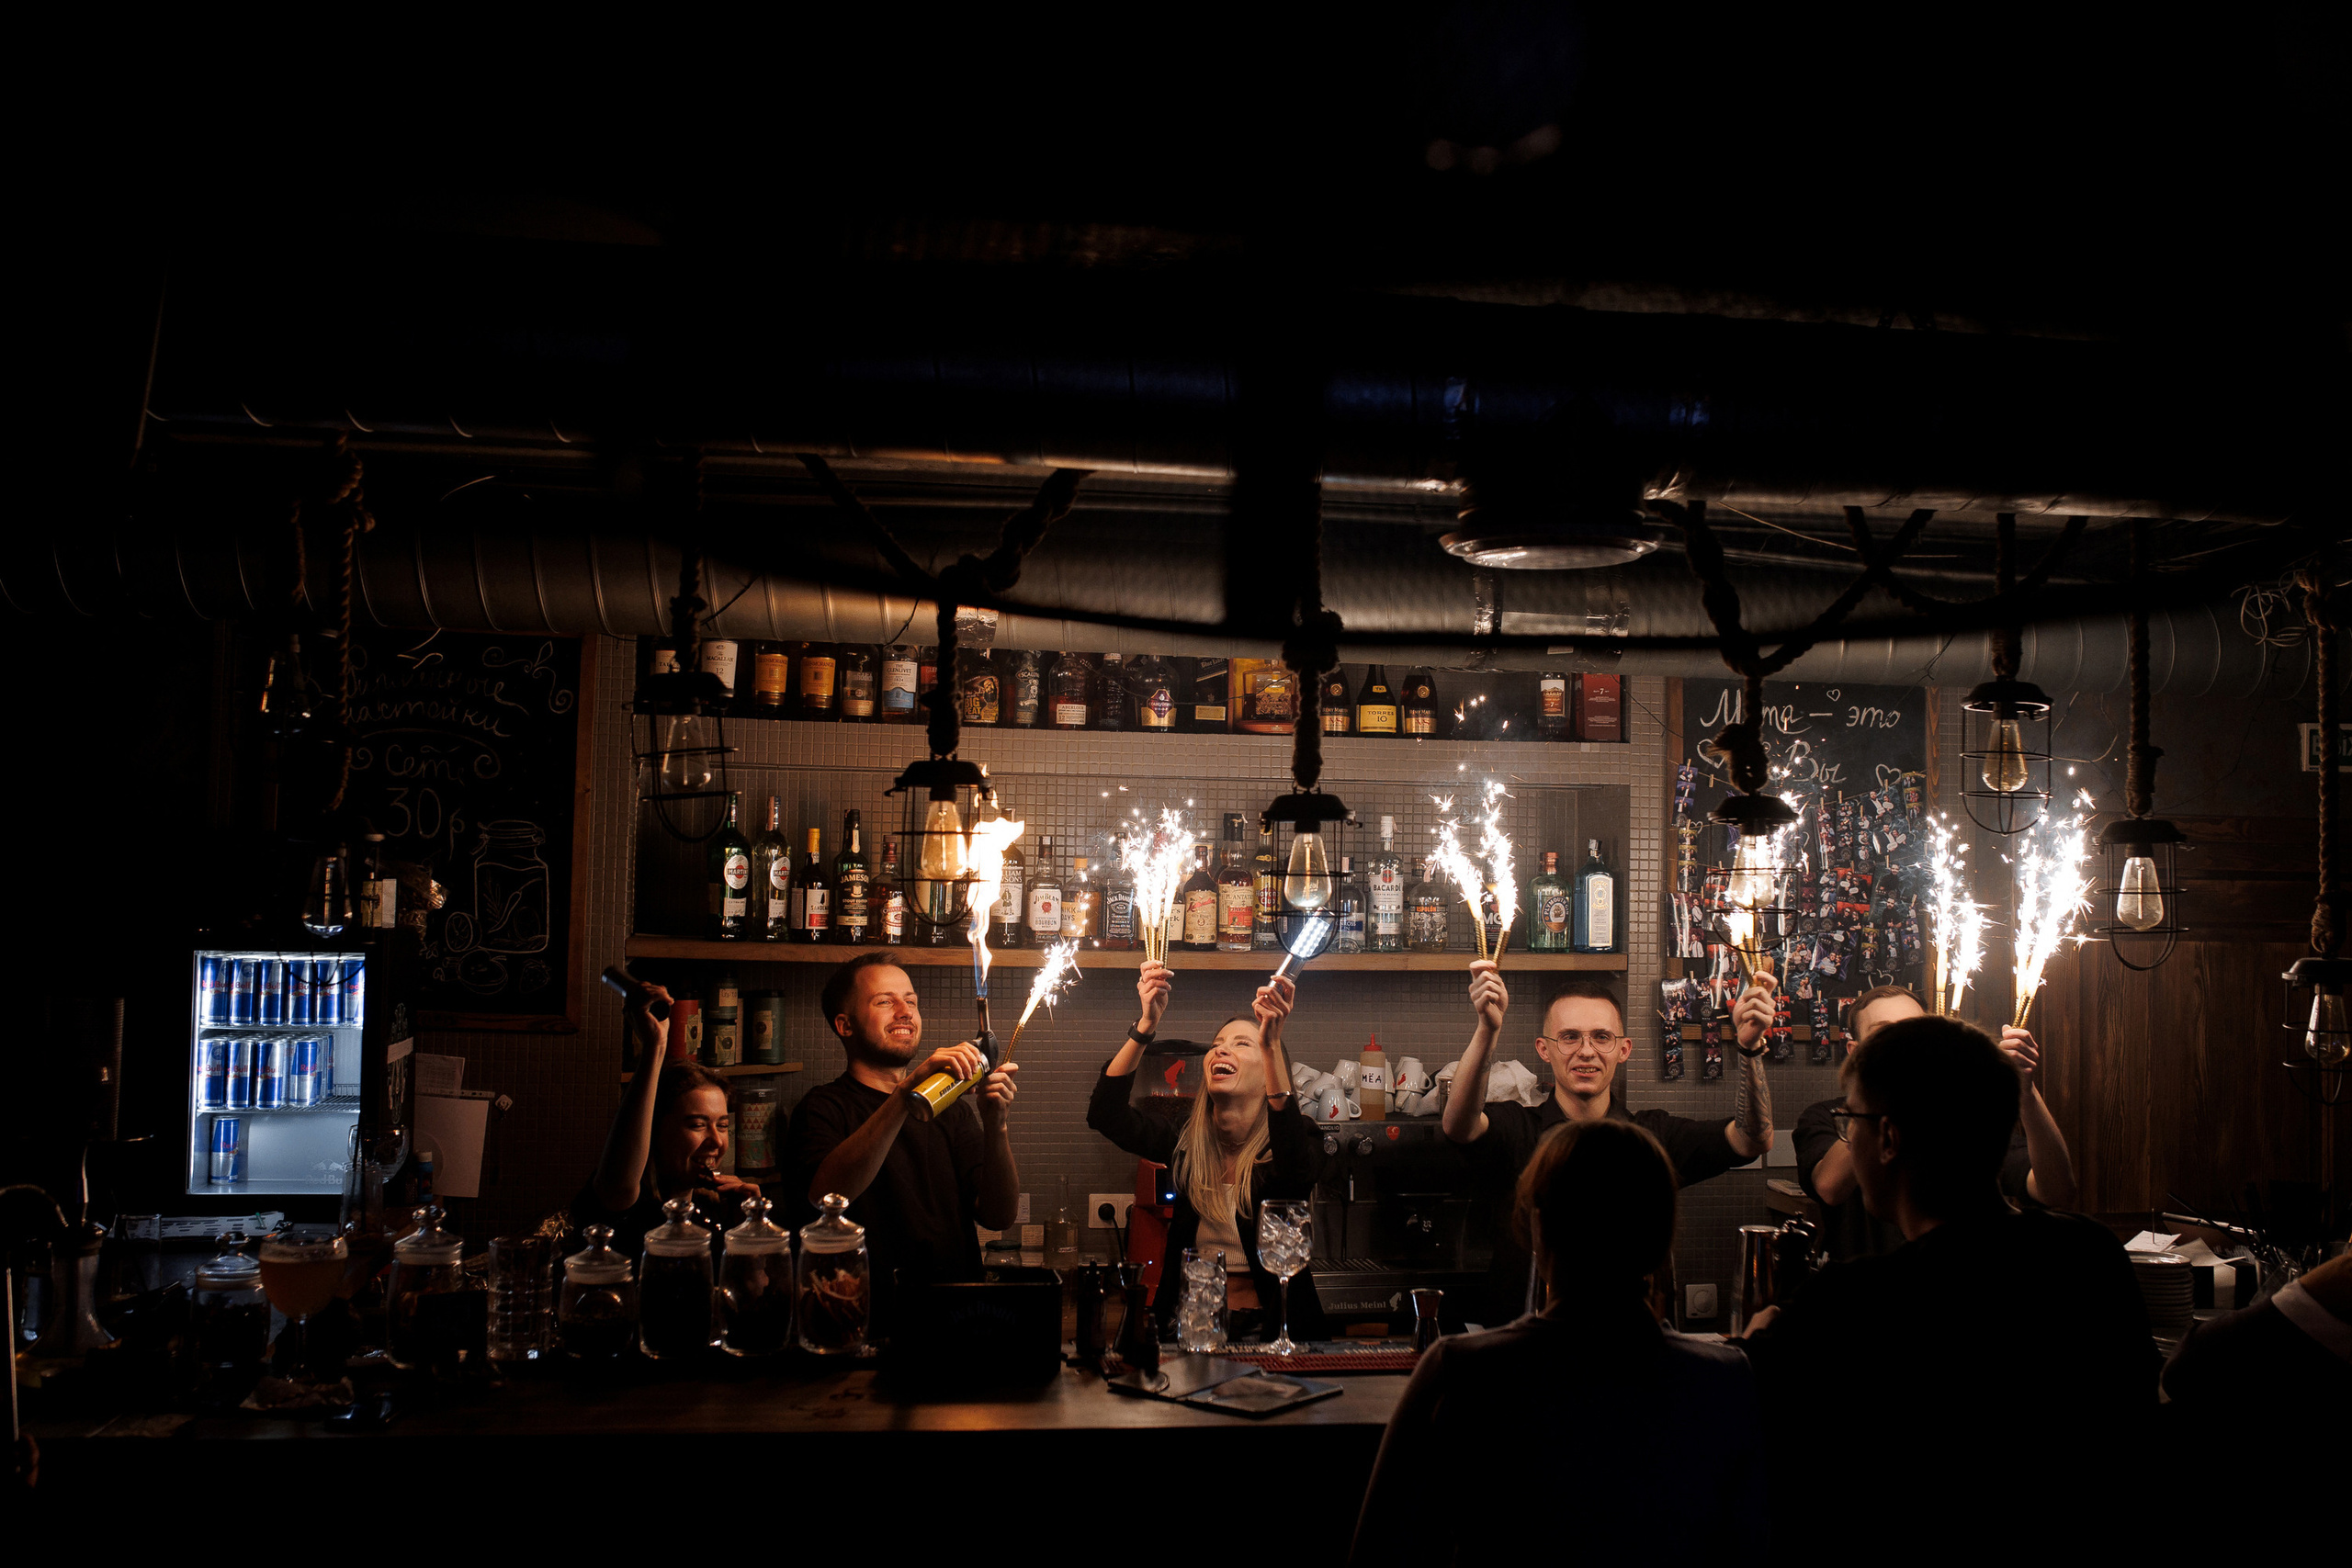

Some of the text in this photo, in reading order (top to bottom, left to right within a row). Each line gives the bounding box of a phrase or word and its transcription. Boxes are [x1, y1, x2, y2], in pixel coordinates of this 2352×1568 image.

[965, 697, 980, 707] BIG
[1700, 688, 1813, 735] Мта
[1846, 705, 1901, 728] это
[1373, 883, 1401, 892] BACARDÍ
[1544, 897, 1566, 915] PLYMOUTH
[328, 1172, 345, 1185] Bu
[1328, 1300, 1387, 1310] Julius Meinl
